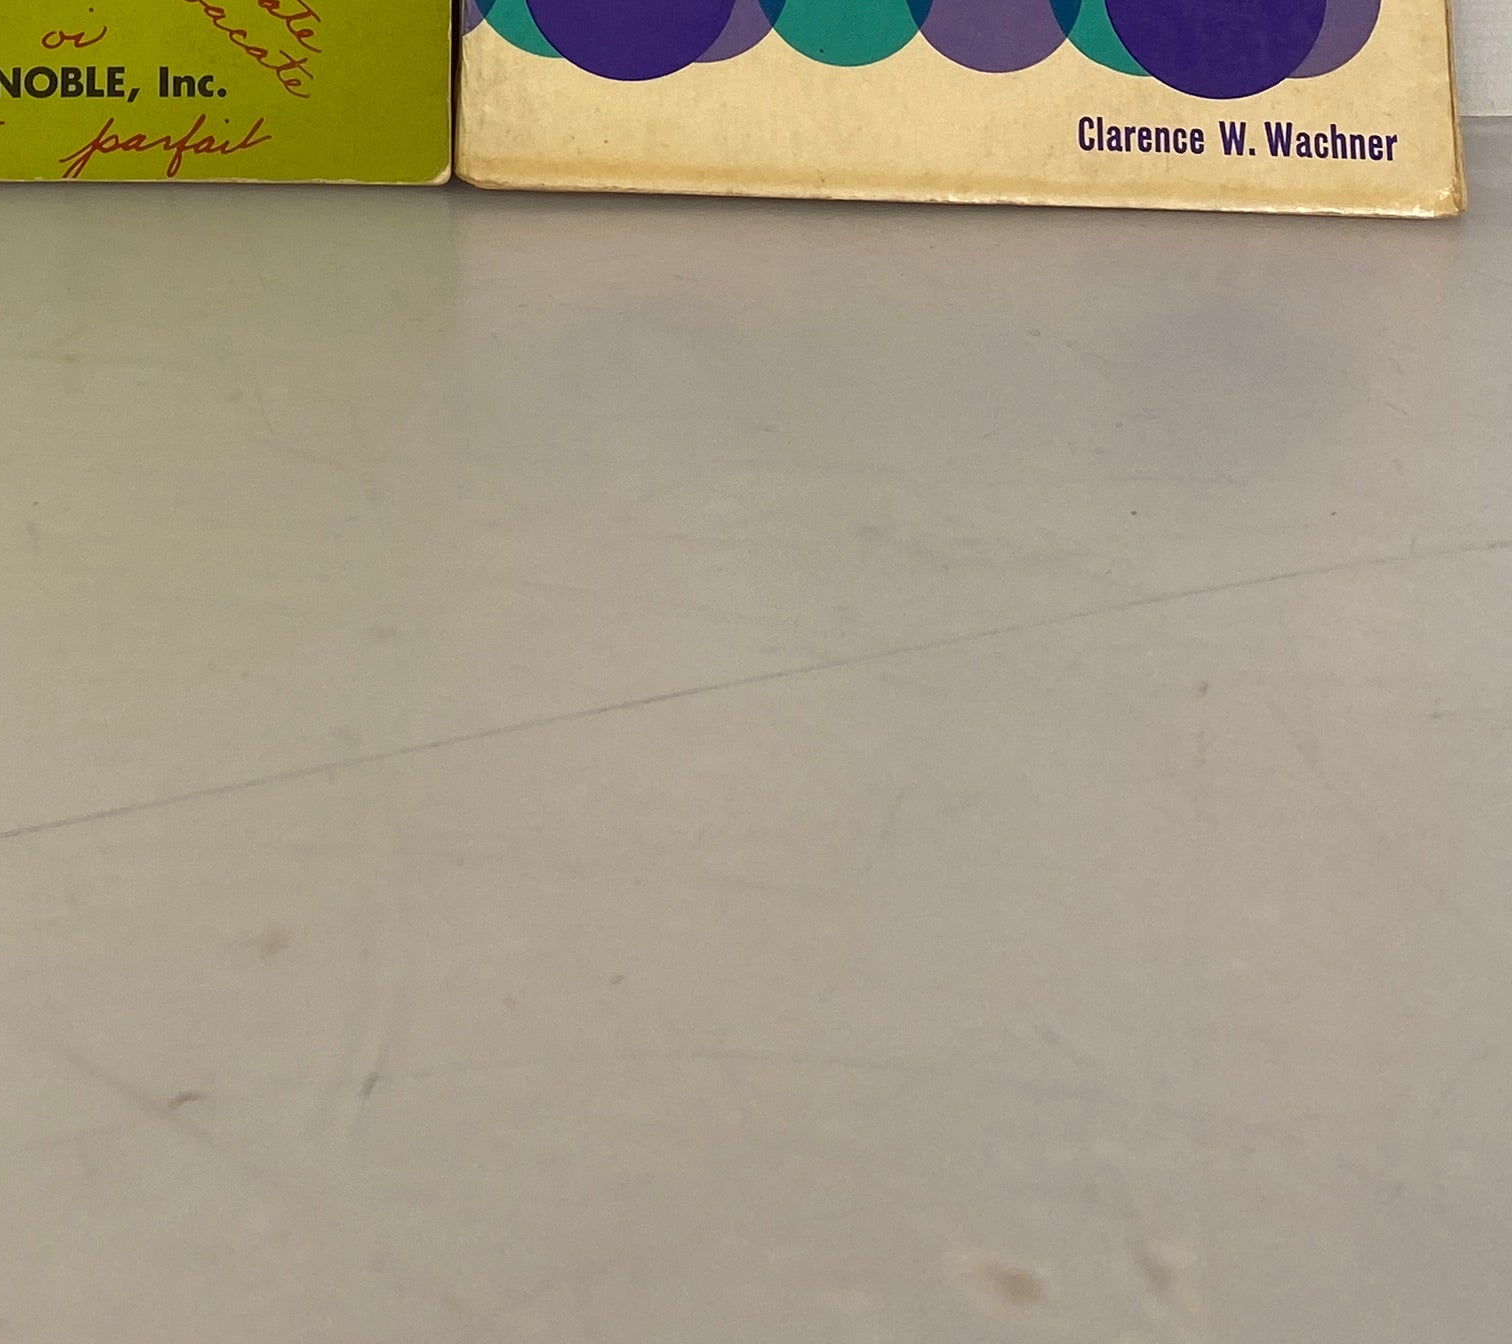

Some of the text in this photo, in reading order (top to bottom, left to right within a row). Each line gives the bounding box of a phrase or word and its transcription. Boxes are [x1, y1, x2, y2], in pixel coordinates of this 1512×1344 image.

[158, 66, 228, 99] Inc.
[59, 113, 272, 179] parfait
[1078, 116, 1398, 162] Clarence W. Wachner
